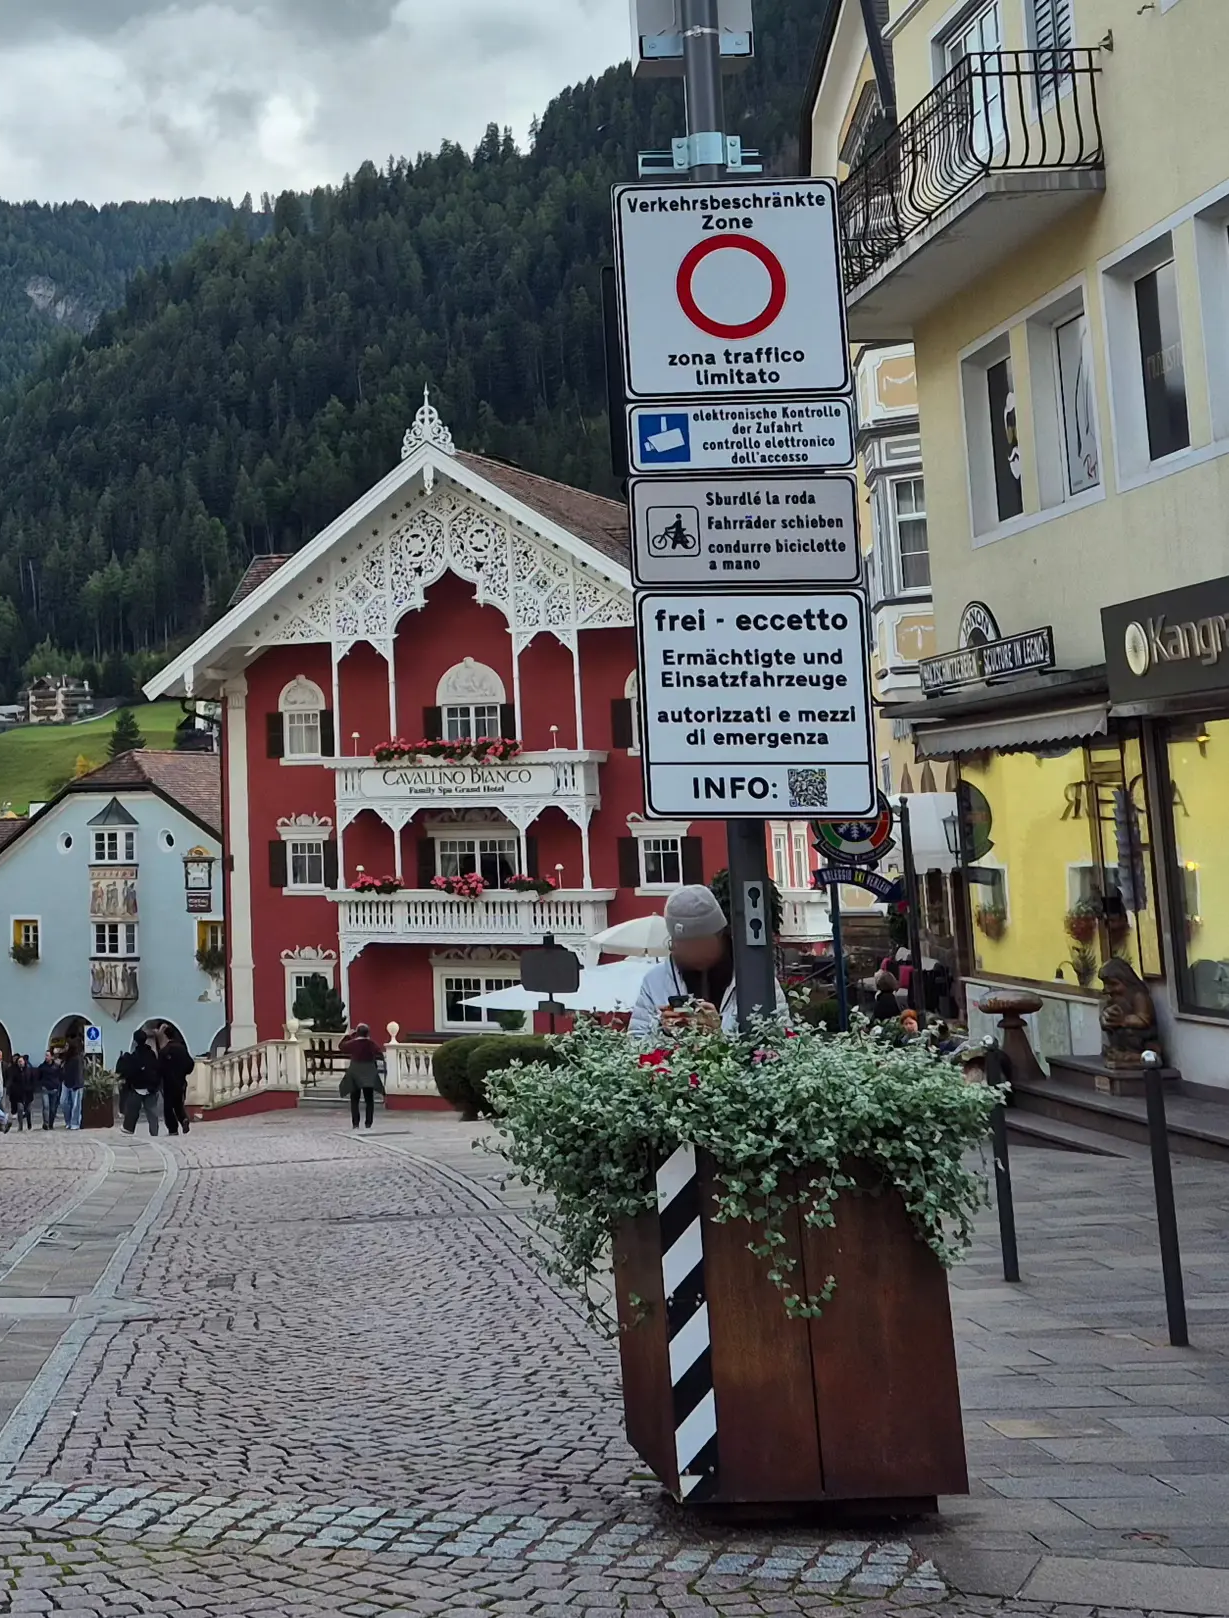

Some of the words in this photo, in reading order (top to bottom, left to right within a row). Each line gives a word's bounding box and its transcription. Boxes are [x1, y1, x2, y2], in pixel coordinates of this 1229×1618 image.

[626, 191, 827, 214] Verkehrsbeschränkte
[701, 215, 754, 231] Zone
[668, 353, 717, 367] zona
[723, 347, 806, 366] traffico
[695, 368, 781, 387] limitato
[692, 408, 778, 423] elektronische
[781, 405, 842, 420] Kontrolle
[731, 424, 753, 436] der
[755, 420, 805, 435] Zufahrt
[702, 437, 762, 452] controllo
[764, 435, 836, 450] elettronico
[731, 451, 809, 466] dell'accesso
[705, 491, 762, 507] Sburdlé
[765, 491, 781, 506] la
[785, 491, 817, 506] roda
[707, 515, 778, 531] Fahrräder
[781, 514, 845, 530] schieben
[707, 540, 772, 554] condurre
[775, 538, 847, 553] biciclette
[708, 560, 718, 571] a
[722, 559, 762, 571] mano
[654, 609, 706, 632] frei
[735, 608, 849, 632] eccetto
[1148, 613, 1229, 667] Kangr
[662, 649, 797, 670] Ermächtigte
[803, 648, 844, 666] und
[661, 671, 849, 691] Einsatzfahrzeuge
[657, 706, 772, 724] autorizzati
[778, 710, 792, 723] e
[797, 706, 857, 723] mezzi
[685, 728, 707, 746] di
[713, 732, 830, 749] emergenza
[382, 768, 466, 786] CAVALLINO
[471, 767, 532, 785] BIANCO
[409, 786, 436, 795] Family
[454, 786, 481, 794] Grand
[483, 784, 505, 793] Hotel
[692, 776, 778, 800] INFO:
